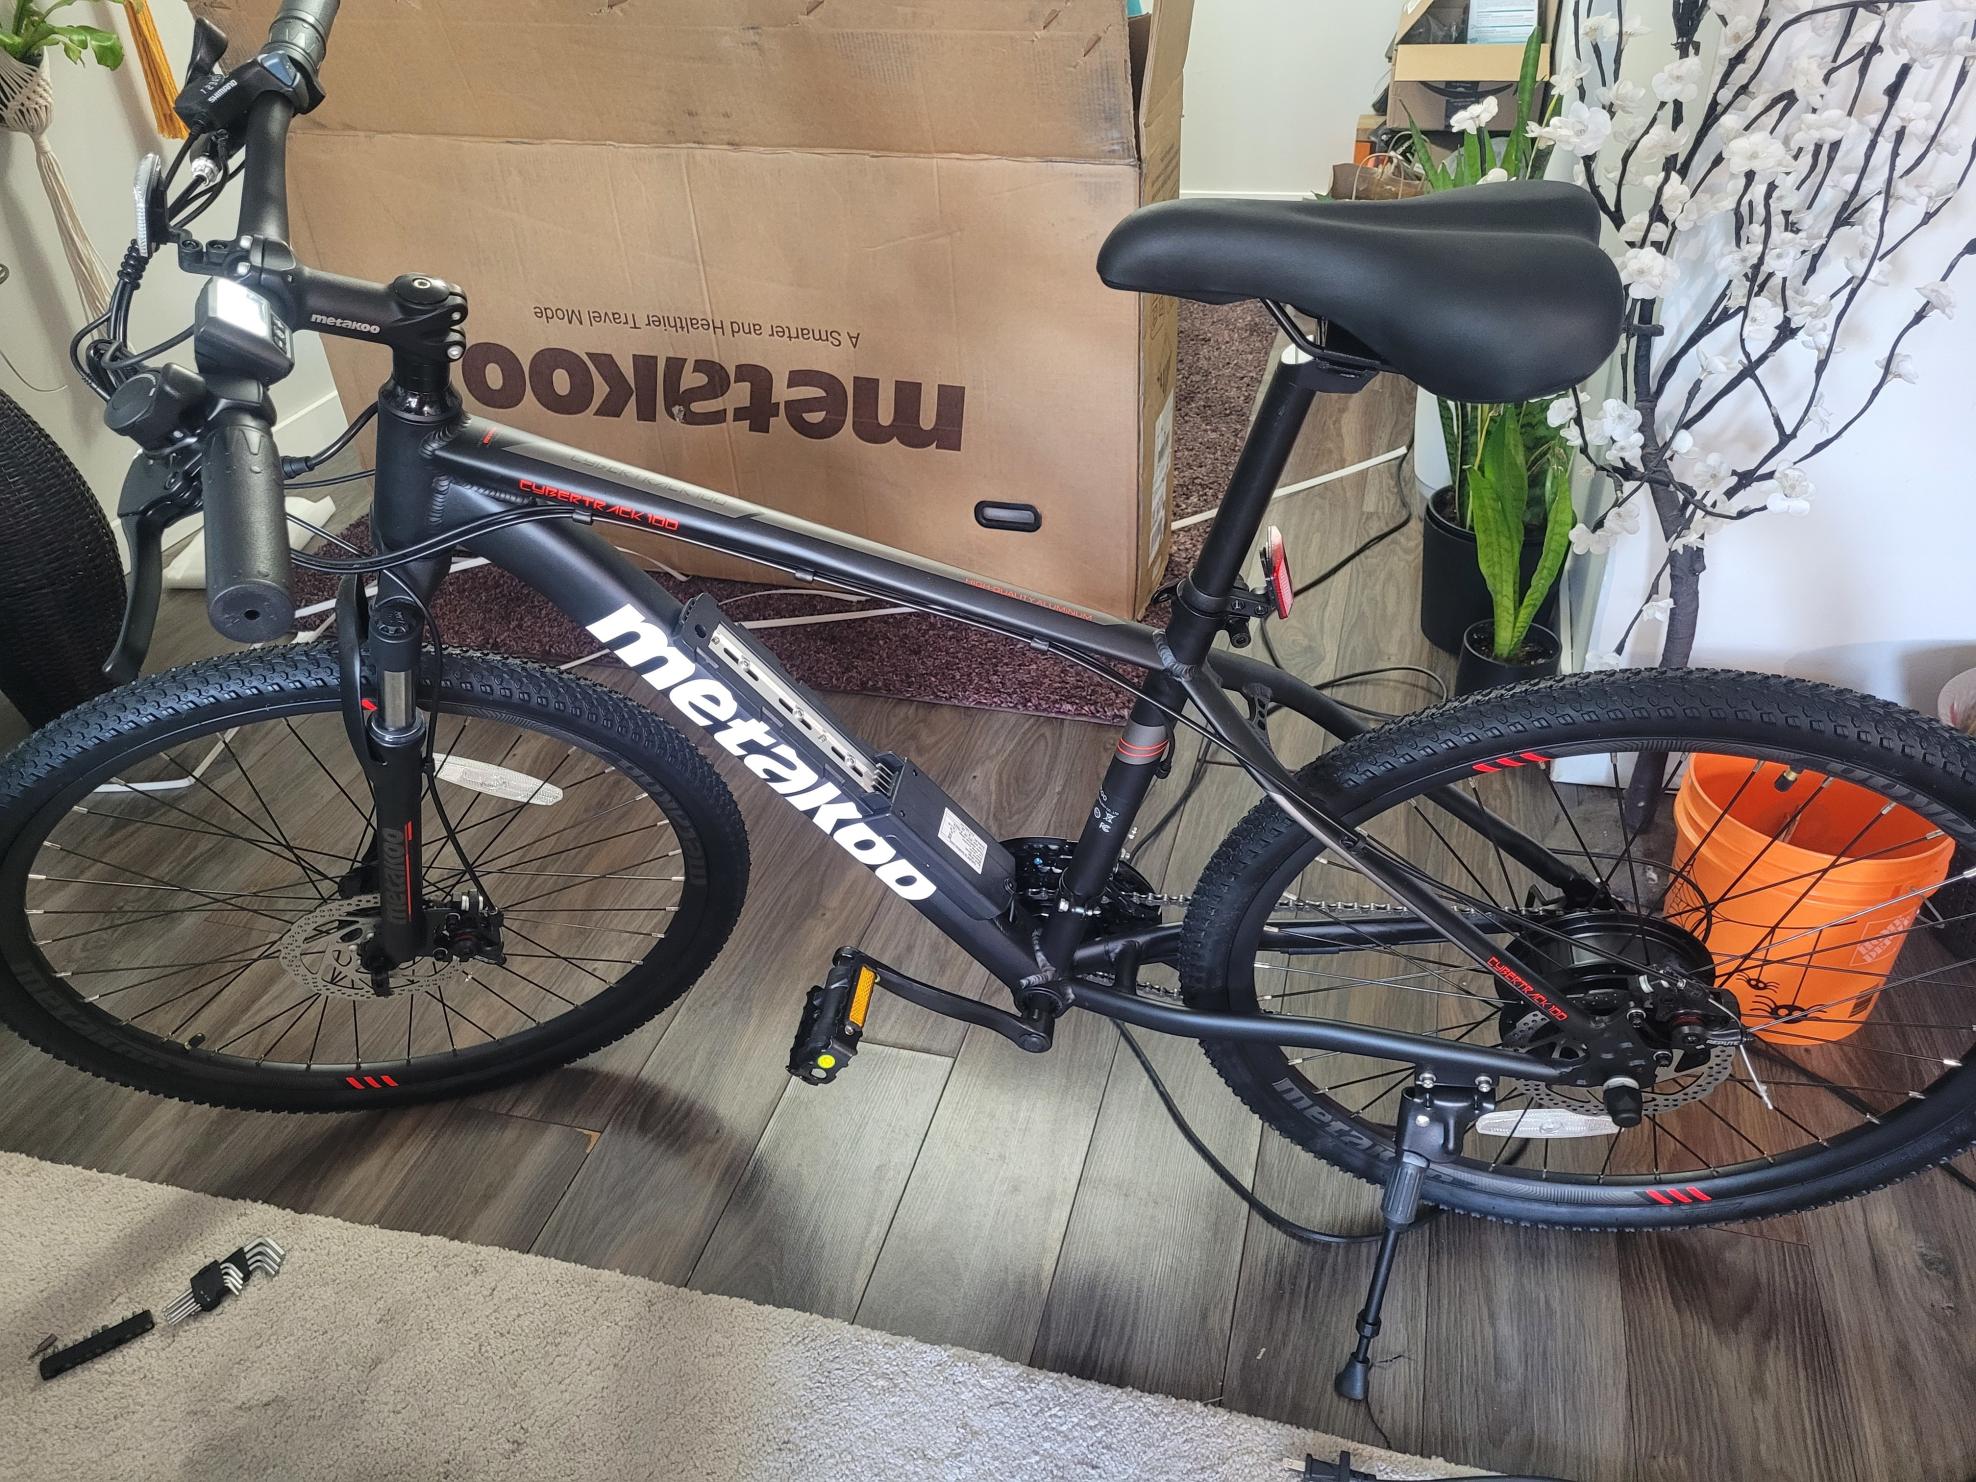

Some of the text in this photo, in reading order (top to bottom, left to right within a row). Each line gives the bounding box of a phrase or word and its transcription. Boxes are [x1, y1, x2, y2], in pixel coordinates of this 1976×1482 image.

[208, 79, 238, 103] SHIMANO
[310, 313, 381, 334] metakoo
[532, 304, 861, 350] A Smarter and Healthier Travel Mode
[461, 341, 967, 452] metakoo
[518, 479, 680, 532] CYBERTRACK 100
[1035, 600, 1094, 622] ALUMINUM
[585, 602, 938, 901] metakoo
[1486, 955, 1570, 1022] CYBERTRACK 100
[1706, 1039, 1740, 1047] REPUTE
